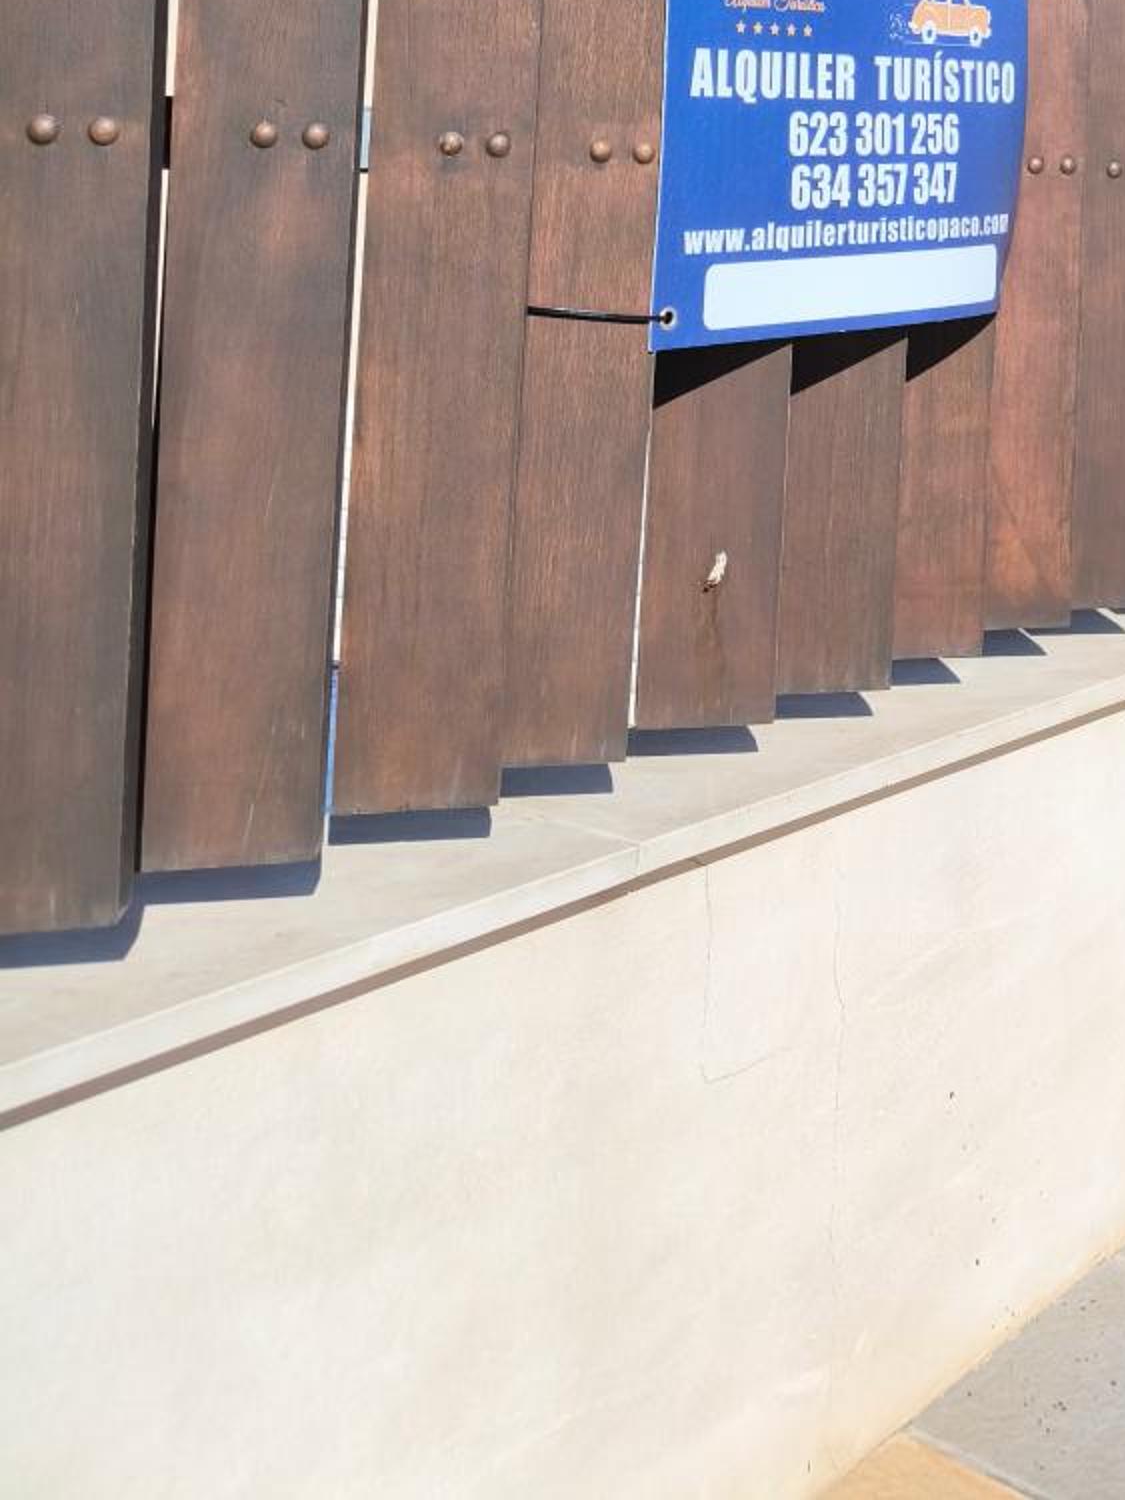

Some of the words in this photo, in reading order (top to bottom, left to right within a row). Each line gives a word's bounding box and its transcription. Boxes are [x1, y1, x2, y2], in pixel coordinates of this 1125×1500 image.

[690, 48, 856, 103] ALQUILER
[874, 52, 1016, 104] TURÍSTICO
[789, 111, 847, 157] 623
[855, 113, 906, 156] 301
[911, 113, 960, 155] 256
[791, 164, 850, 210] 634
[857, 163, 908, 207] 357
[913, 161, 957, 204] 347
[684, 213, 1009, 255] www.alquilerturisticopaco.com
